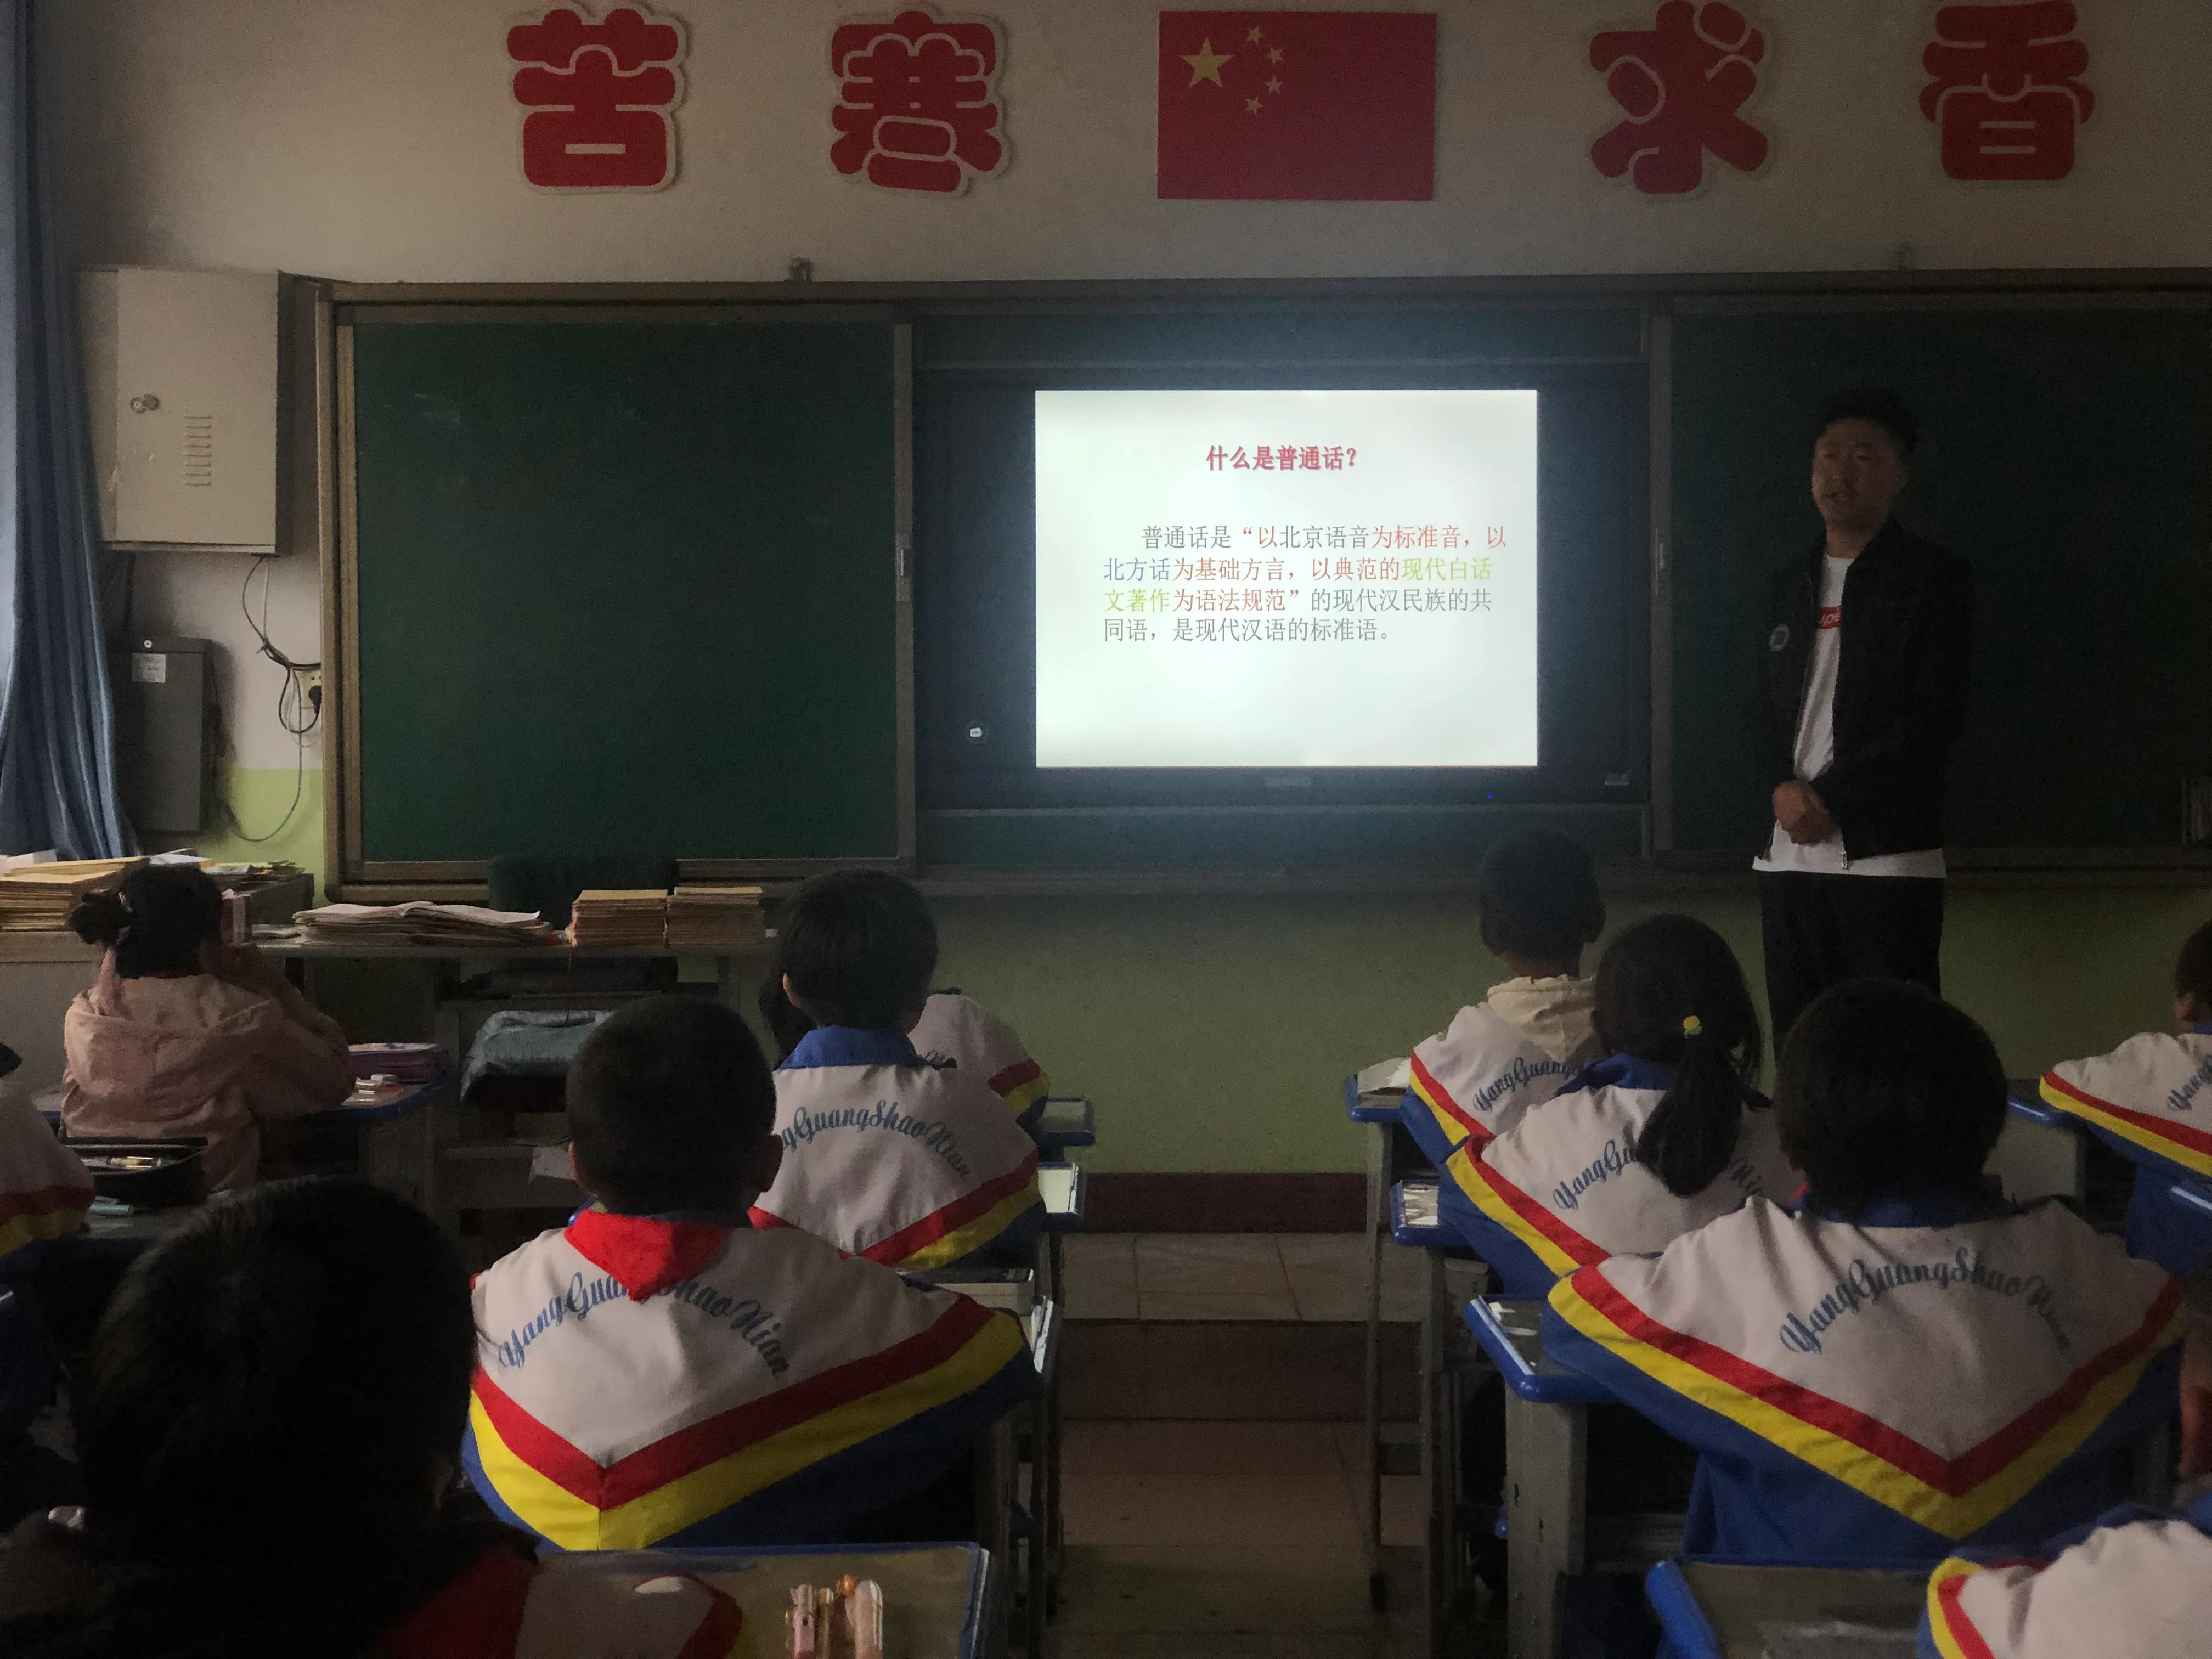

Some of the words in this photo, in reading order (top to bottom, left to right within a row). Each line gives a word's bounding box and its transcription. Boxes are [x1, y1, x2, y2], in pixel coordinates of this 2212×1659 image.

[506, 7, 679, 187] 苦
[830, 11, 1002, 193] 寒
[1918, 0, 2096, 181] 香
[1206, 445, 1357, 471] 什么是普通话？
